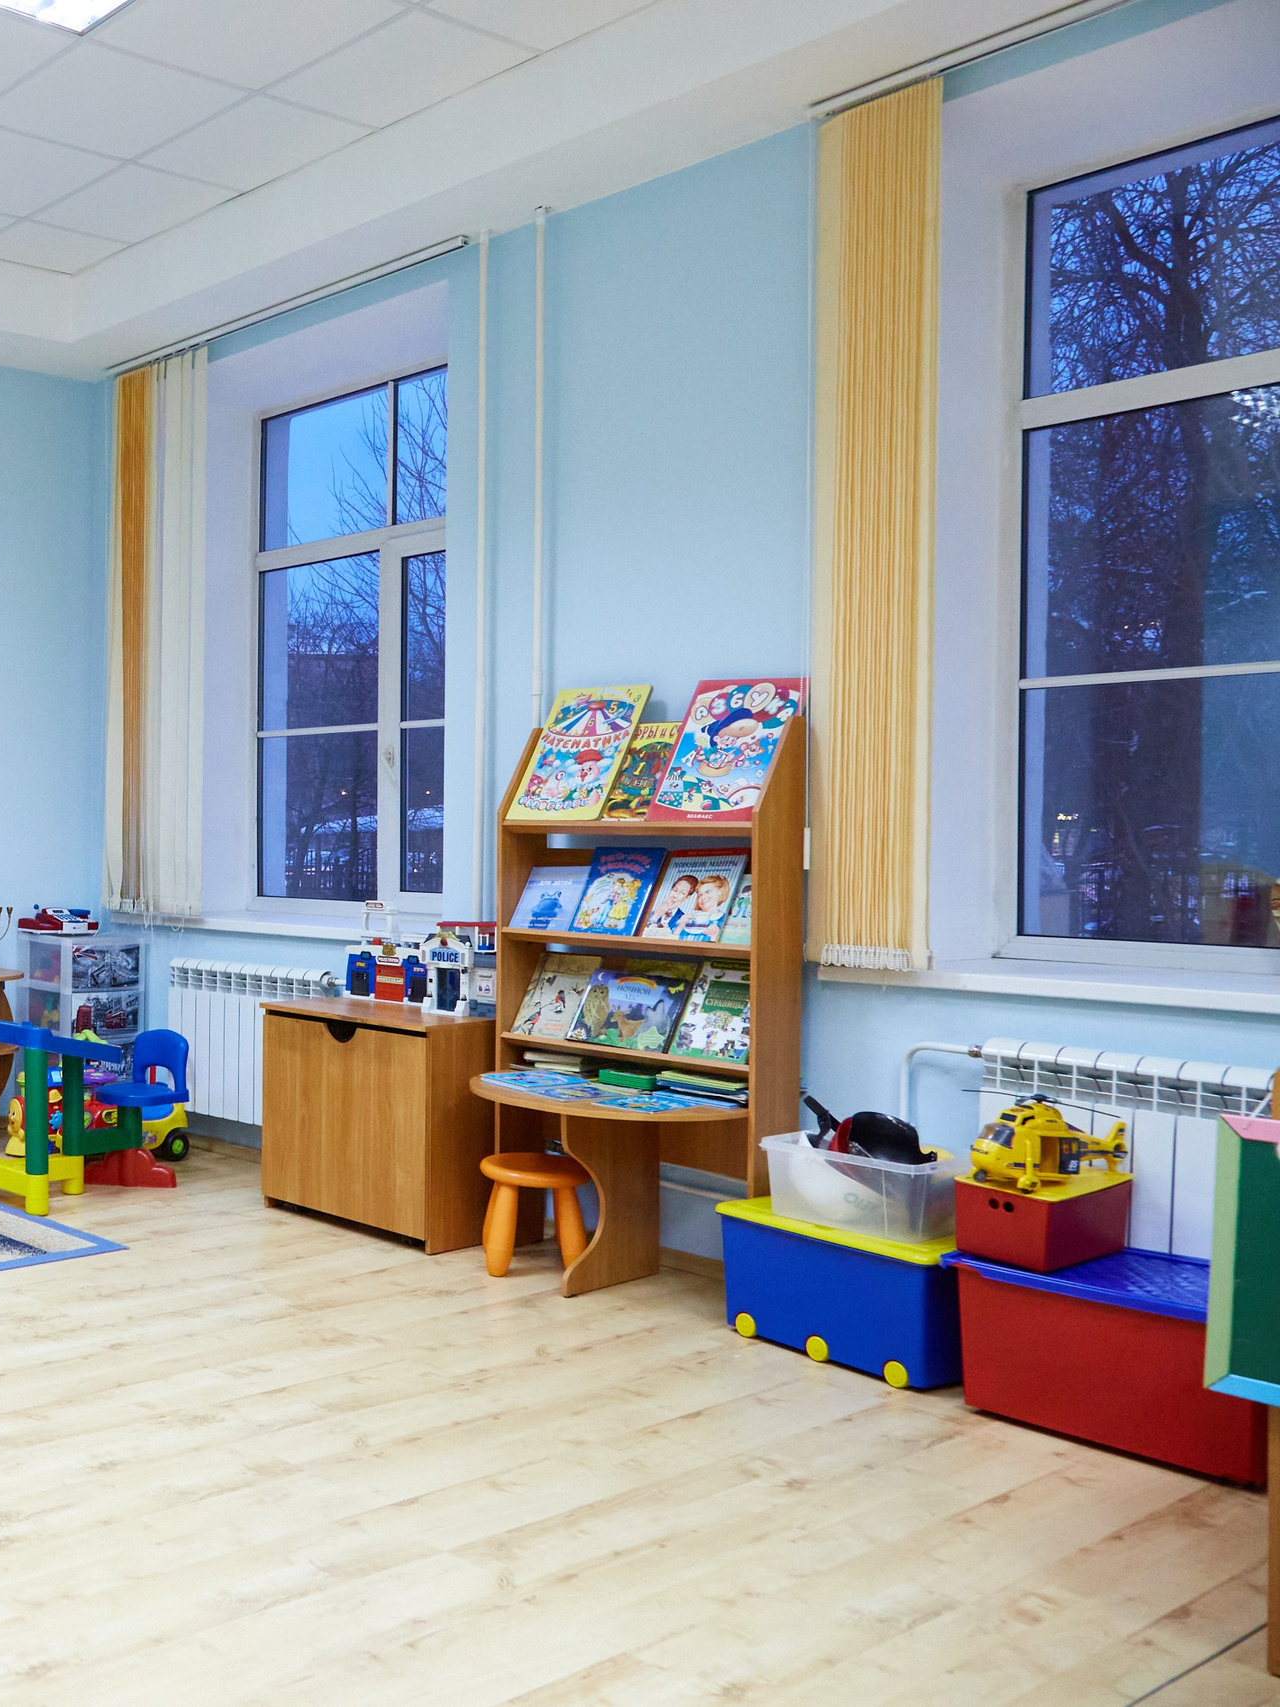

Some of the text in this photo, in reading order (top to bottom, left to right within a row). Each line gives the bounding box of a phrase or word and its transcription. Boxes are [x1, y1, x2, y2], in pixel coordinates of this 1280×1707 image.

[609, 701, 619, 714] 5
[695, 691, 794, 721] АЗБУКА
[634, 725, 657, 739] ФРЫ
[541, 730, 630, 749] МАТЕМАТИКА
[432, 951, 459, 963] POLICE
